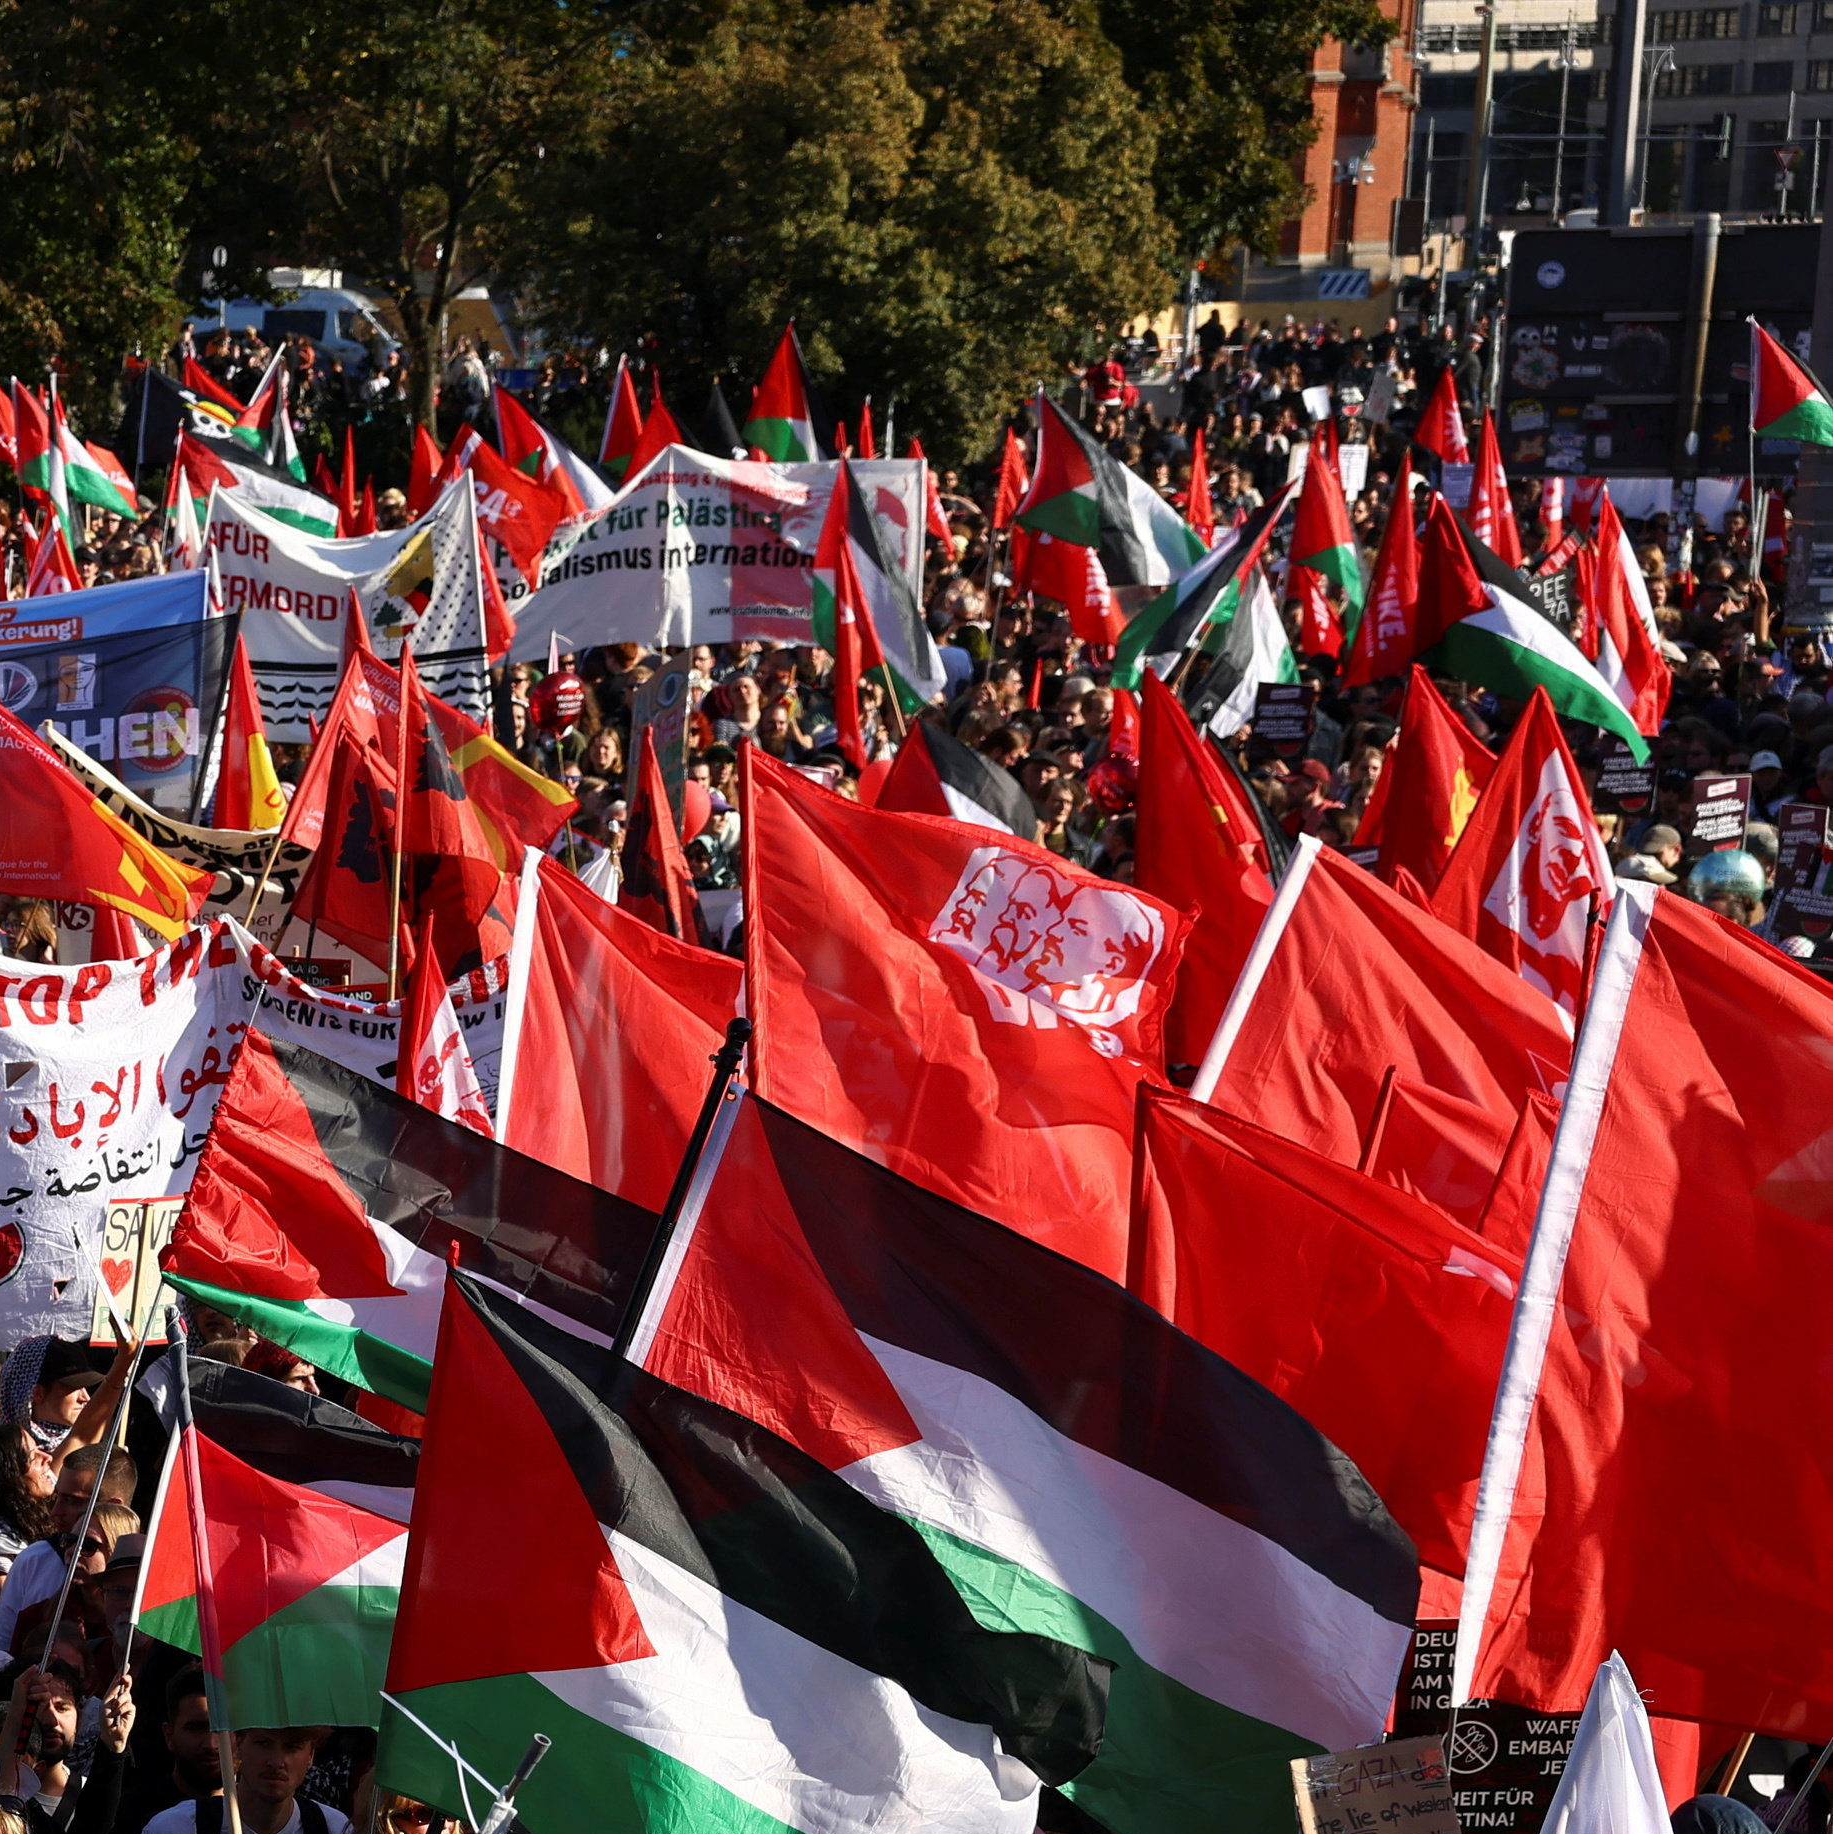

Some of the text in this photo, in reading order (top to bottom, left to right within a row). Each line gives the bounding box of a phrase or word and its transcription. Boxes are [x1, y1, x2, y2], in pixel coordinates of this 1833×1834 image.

[8, 869, 62, 882] International
[136, 919, 238, 1008] THE
[1349, 1807, 1377, 1831] lie
[1379, 1802, 1402, 1824] of
